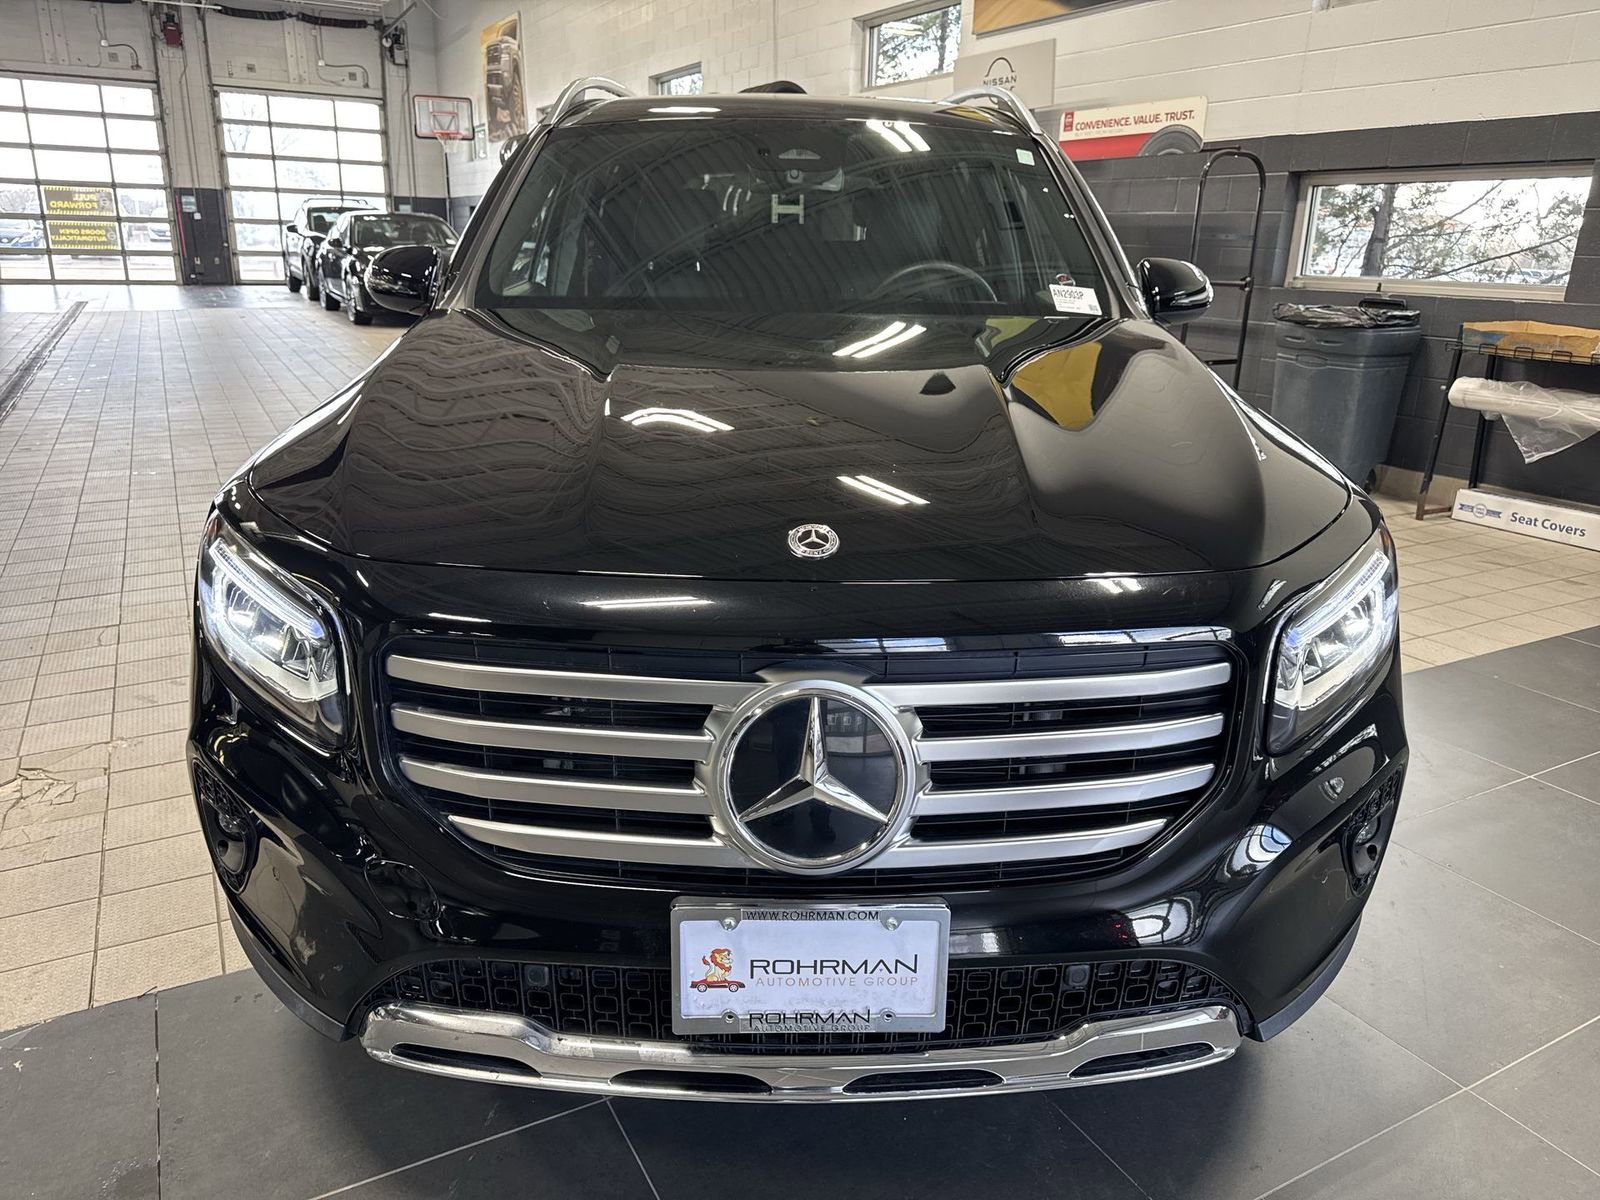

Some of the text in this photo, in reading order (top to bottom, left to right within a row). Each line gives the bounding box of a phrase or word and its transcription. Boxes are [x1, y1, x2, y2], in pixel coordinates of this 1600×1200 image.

[983, 75, 1018, 87] NISSAN
[1074, 117, 1132, 131] CONVENIENCE.
[1133, 114, 1163, 125] VALUE.
[1165, 110, 1195, 122] TRUST.
[1510, 512, 1586, 537] Seat Covers
[746, 910, 880, 921] WWW.ROHRMAN.COM
[750, 954, 918, 979] ROHRMAN
[755, 976, 919, 987] AUTOMOTIVE GROUP
[749, 1009, 871, 1028] ROHRMAN
[753, 1024, 872, 1032] AUTOMOTIVE GROUP
